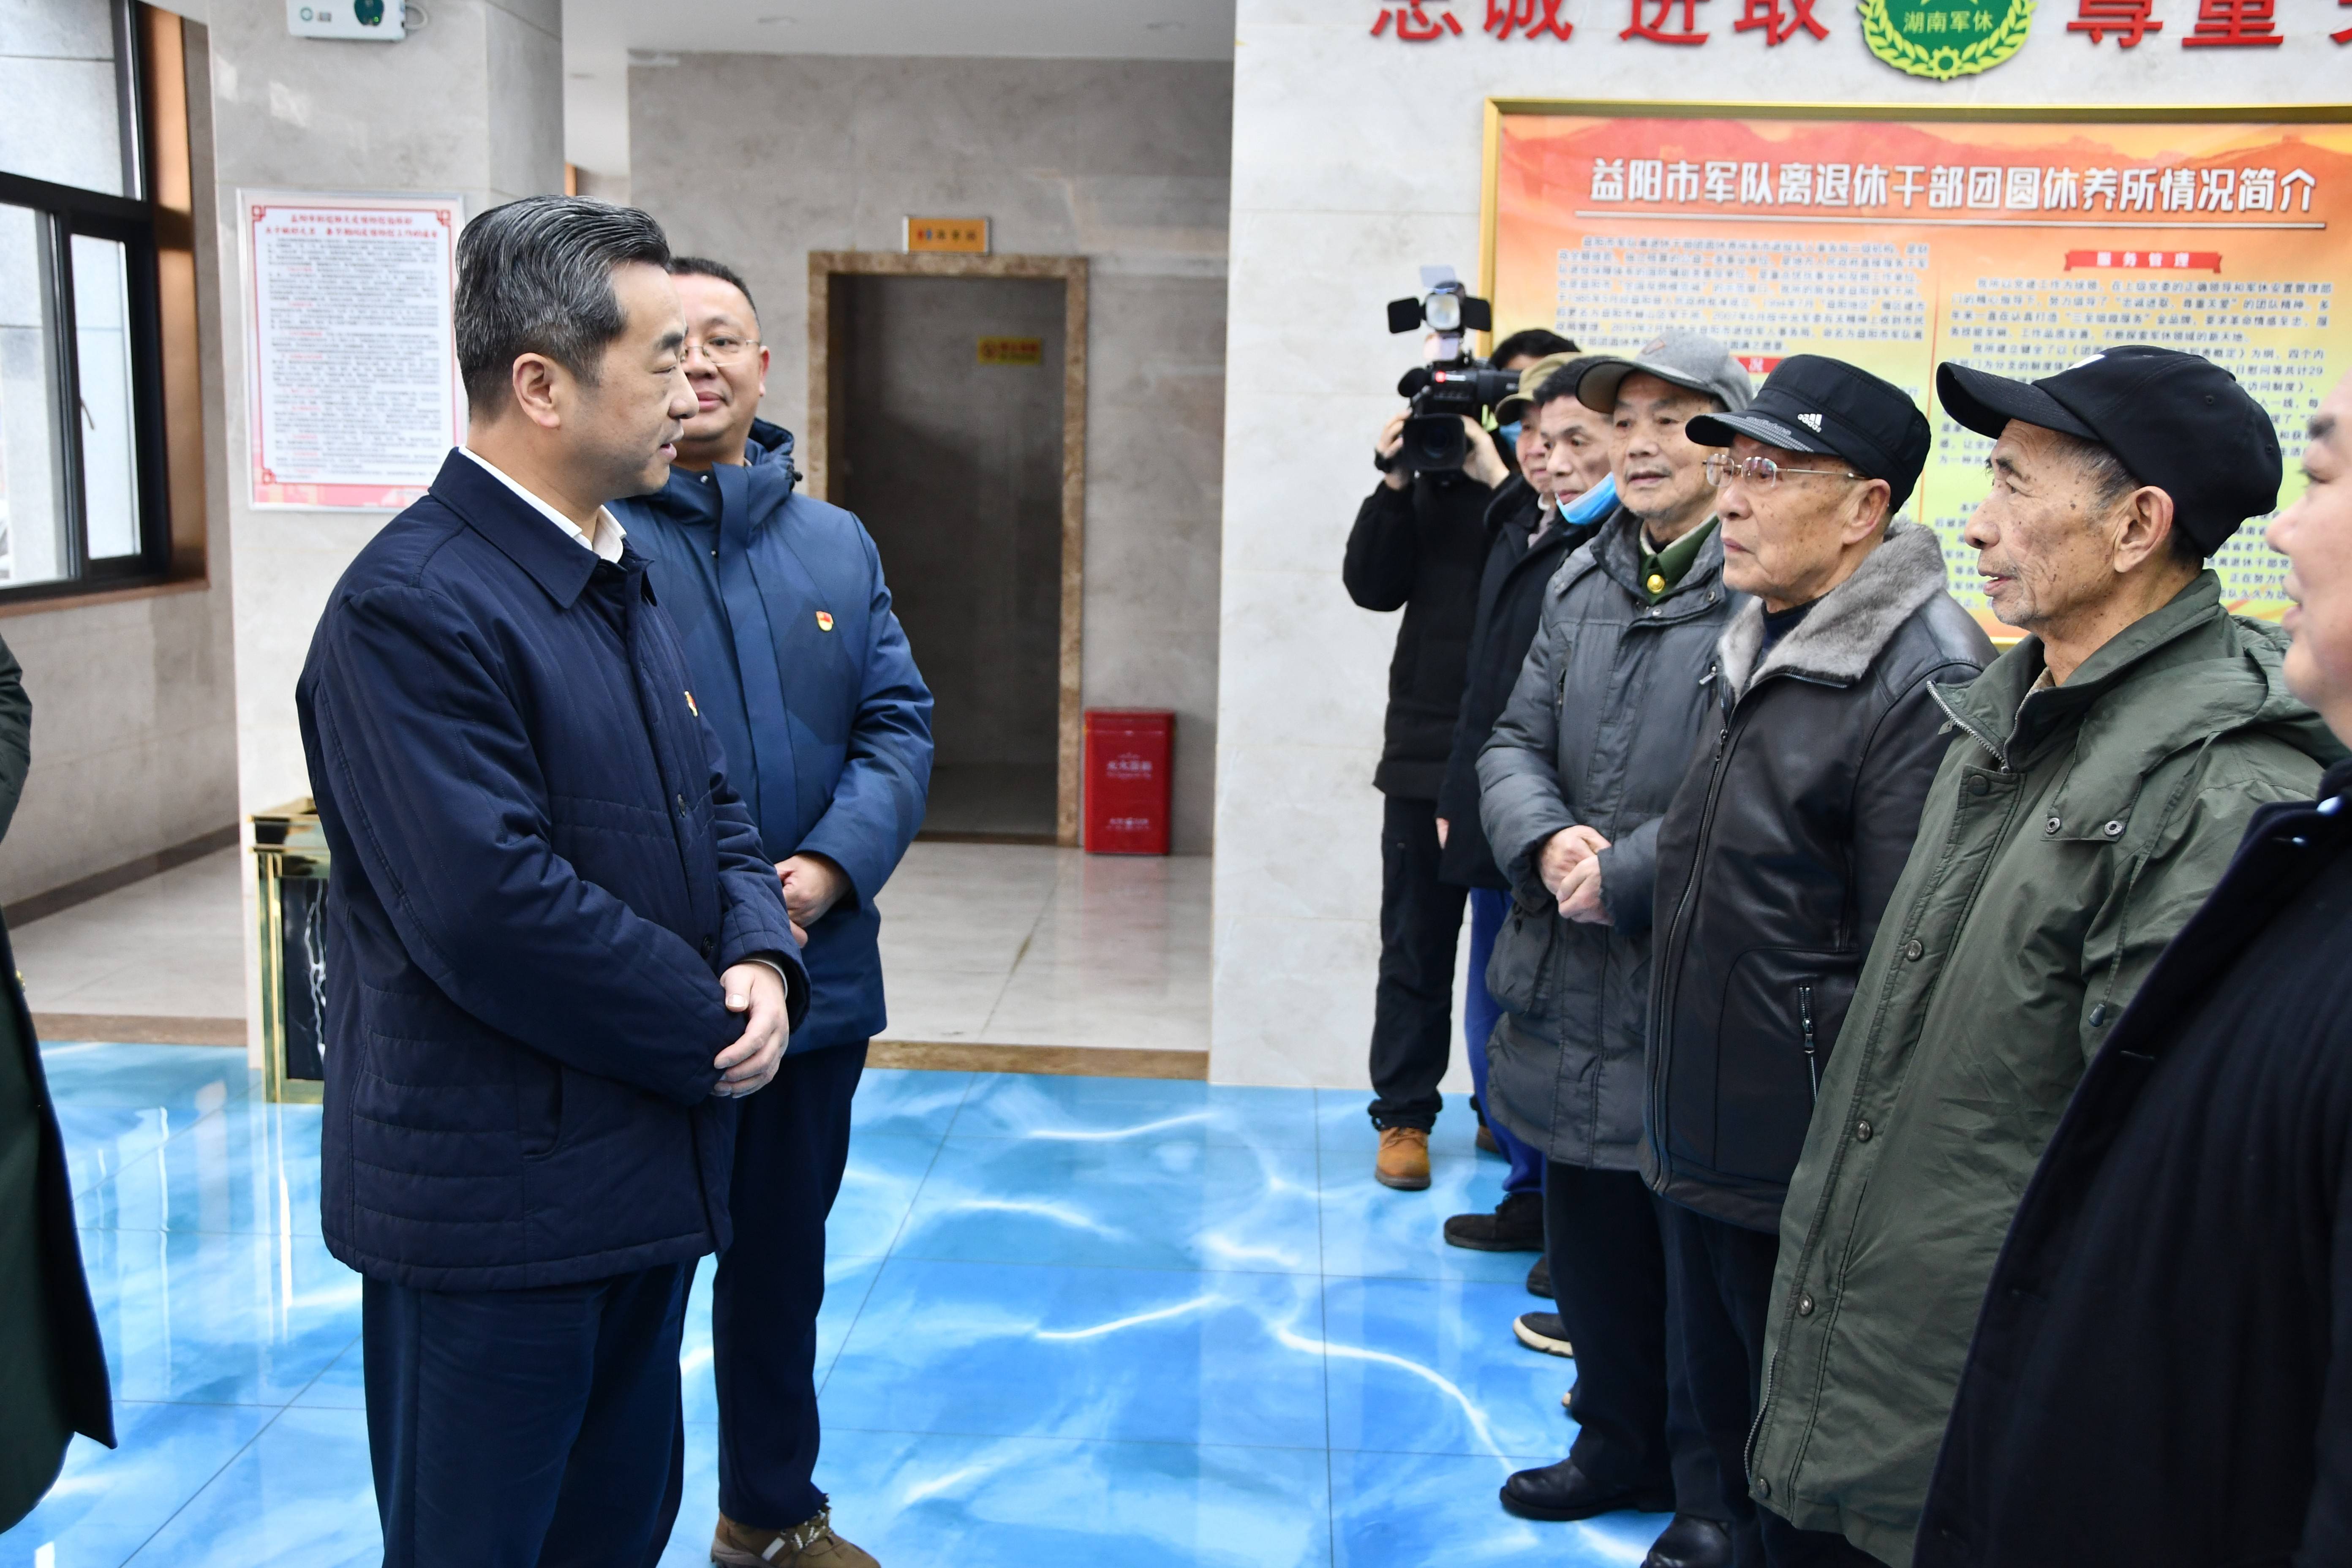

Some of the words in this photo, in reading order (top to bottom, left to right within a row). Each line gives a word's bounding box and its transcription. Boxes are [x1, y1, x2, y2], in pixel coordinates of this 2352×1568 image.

[1903, 10, 1993, 34] 湖南军休
[1590, 158, 2316, 212] 益阳市军队离退休干部团圆休养所情况简介
[1797, 414, 1822, 433] adidas
